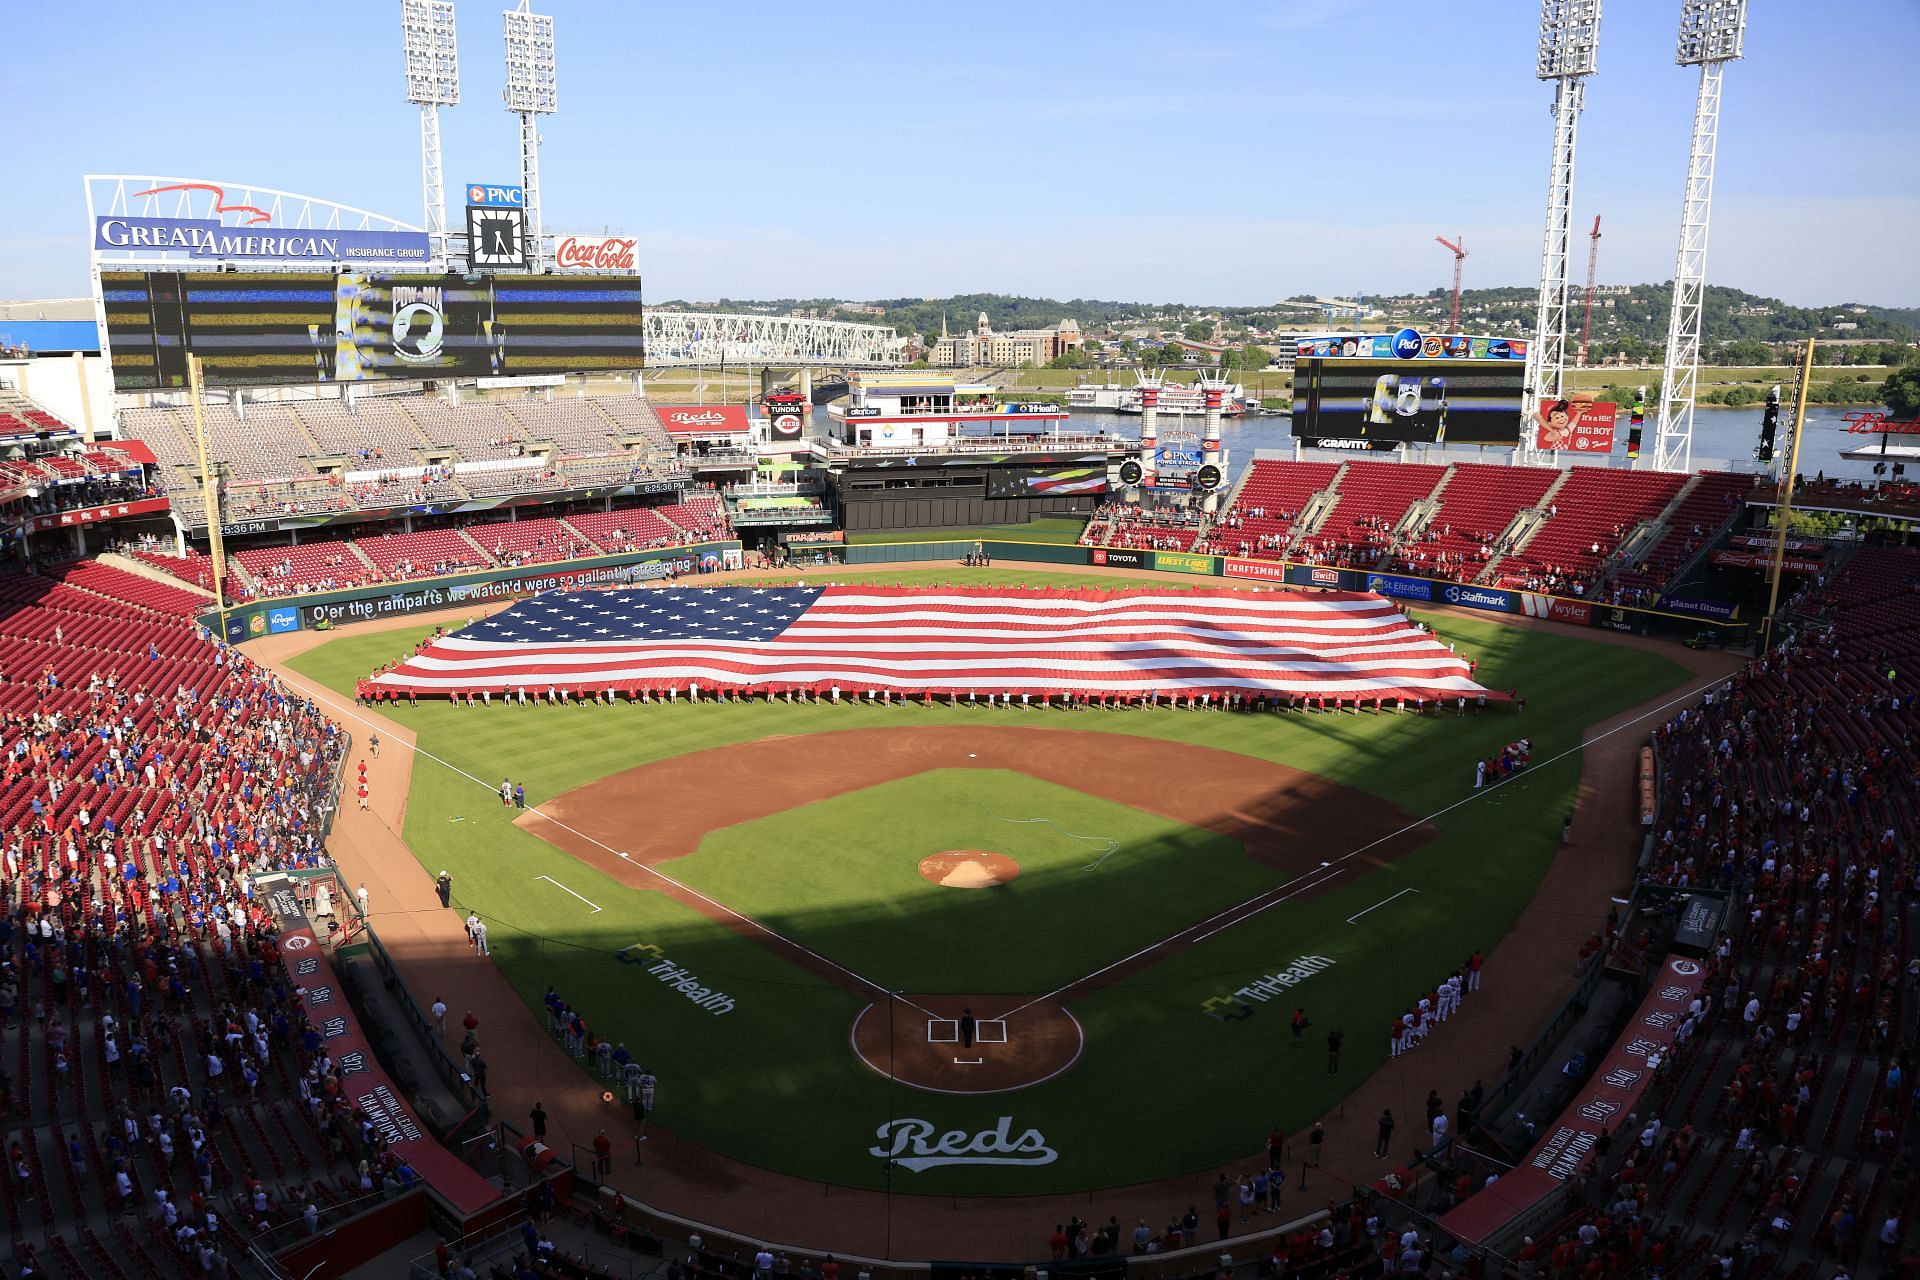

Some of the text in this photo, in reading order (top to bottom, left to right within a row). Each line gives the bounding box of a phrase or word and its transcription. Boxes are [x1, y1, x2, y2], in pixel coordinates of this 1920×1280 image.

[487, 187, 521, 203] PNC
[101, 220, 425, 258] GREAT AMERICAN INSURANCE GROUP
[556, 237, 638, 269] Coca-Cola
[1398, 338, 1420, 350] P&G
[1424, 341, 1441, 352] Tide
[1028, 403, 1059, 413] TriHealth
[670, 410, 727, 425] Reds
[1581, 414, 1593, 422] It's
[1576, 426, 1611, 436] BIG BOY
[1321, 439, 1369, 450] GRAVITY
[1173, 451, 1195, 461] PNC
[673, 482, 685, 490] PM
[219, 522, 266, 535] 25:36 PM
[1108, 554, 1138, 563] TOYOTA
[1158, 556, 1209, 568] WEST LAKE
[1227, 563, 1281, 577] CRAFTSMAN
[1790, 562, 1803, 570] FOR
[1804, 563, 1818, 571] YOU
[1313, 571, 1336, 581] Swift
[313, 605, 345, 621] O'er
[349, 601, 374, 616] the
[377, 590, 443, 612] ramparts
[447, 592, 466, 602] we
[469, 579, 521, 600] watch'd
[524, 578, 556, 592] were
[559, 575, 574, 587] so
[577, 565, 630, 588] gallantly
[1383, 580, 1430, 594] St Elizabeth
[1460, 591, 1506, 606] Staffmark
[1555, 605, 1587, 618] wyler
[1669, 599, 1731, 615] planet fitness
[271, 613, 296, 627] Kroger
[1601, 620, 1631, 631] BETMGM
[1234, 955, 1337, 1002] TriHealth
[648, 959, 736, 1016] TriHealth
[325, 1017, 345, 1037] 1970
[1626, 1039, 1657, 1057] 1975
[341, 1052, 363, 1074] 1972
[1605, 1069, 1637, 1088] 1940
[358, 1093, 404, 1144] CHAMPIONS
[374, 1085, 422, 1141] NATIONAL LEAGUE
[1582, 1101, 1615, 1121] 1919
[868, 1116, 1059, 1173] Reds
[1531, 1126, 1575, 1169] WORLD SERIES
[1547, 1130, 1598, 1180] CHAMPIONS
